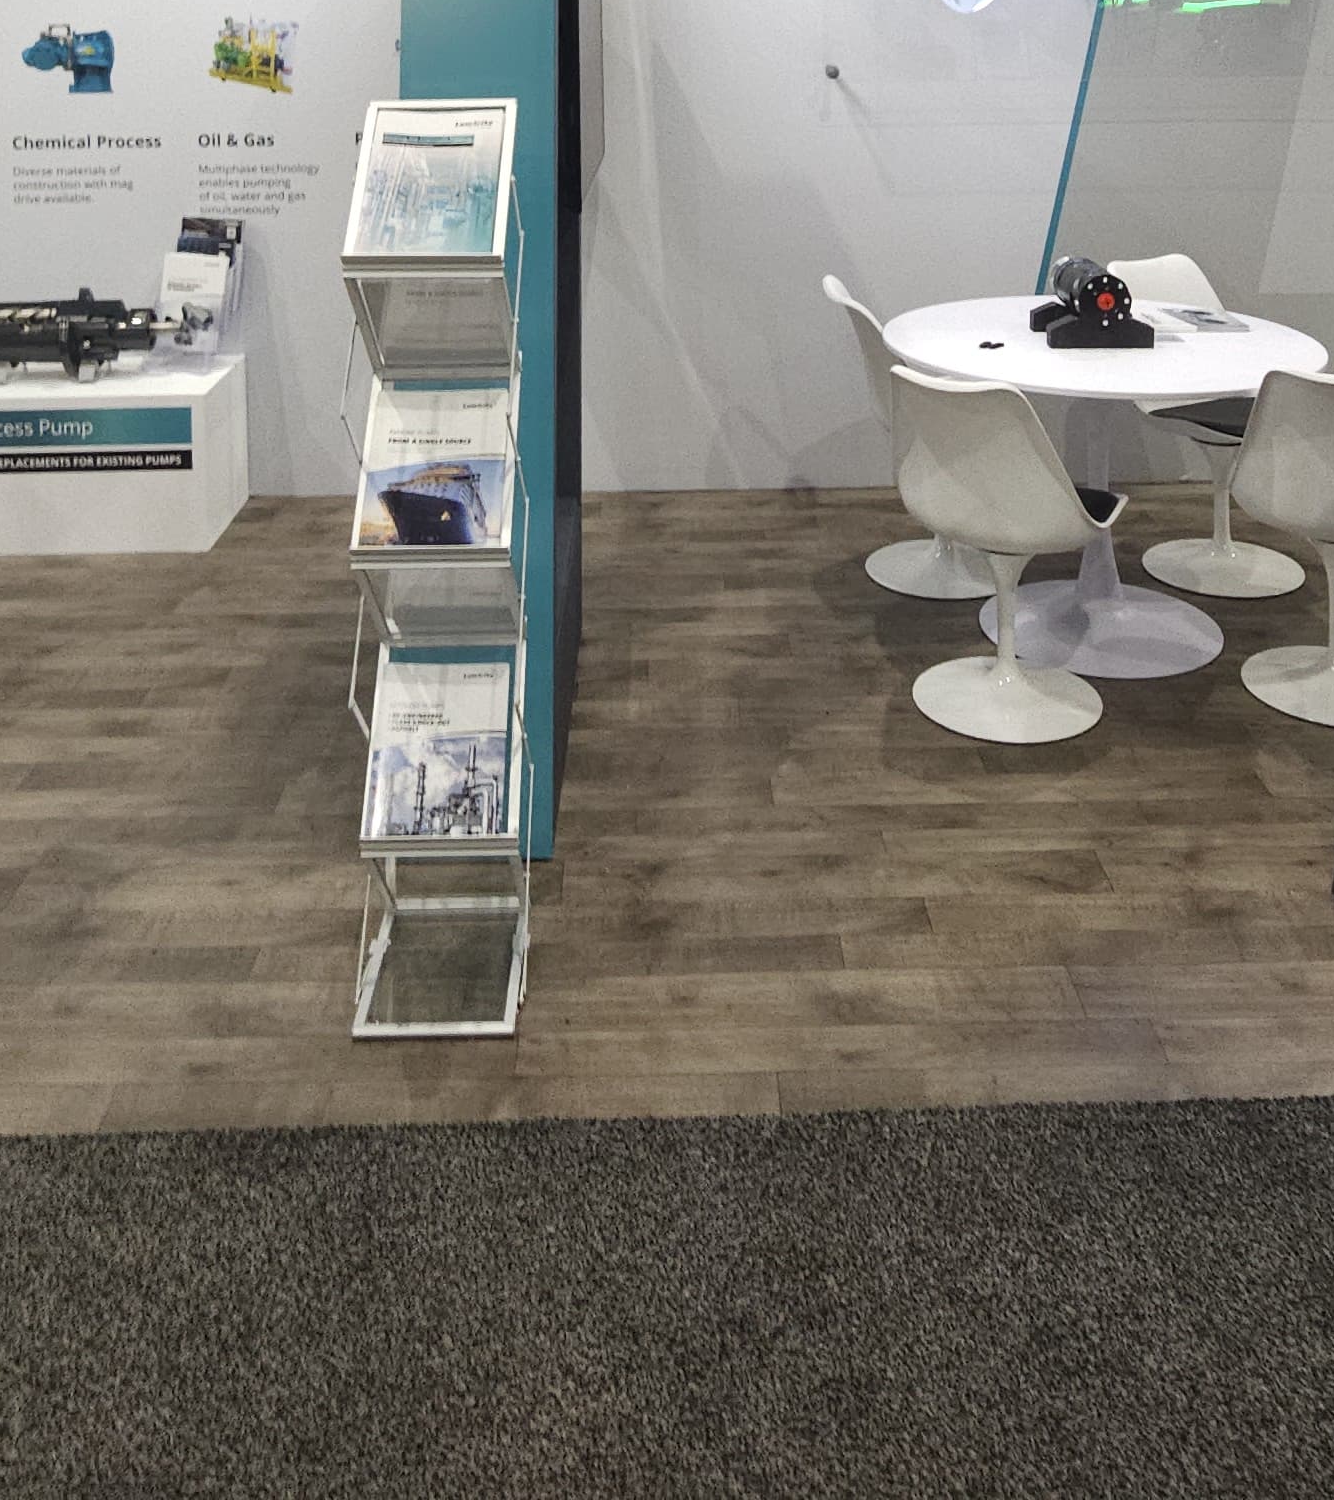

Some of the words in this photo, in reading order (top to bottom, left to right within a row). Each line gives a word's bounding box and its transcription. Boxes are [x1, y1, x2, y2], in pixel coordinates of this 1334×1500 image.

[12, 134, 91, 151] Chemical
[97, 134, 162, 149] Process
[198, 132, 221, 148] Oil
[226, 133, 238, 147] &
[244, 131, 275, 147] Gas
[12, 166, 54, 177] Diverse
[56, 164, 107, 176] materials
[109, 164, 122, 175] of
[198, 163, 258, 176] Multiphase
[260, 162, 320, 176] technology
[13, 180, 82, 191] construction
[83, 179, 107, 189] with
[198, 177, 240, 188] enables
[243, 177, 292, 190] pumping
[13, 193, 41, 204] drive
[199, 191, 211, 202] of
[230, 192, 262, 201] water
[264, 190, 286, 201] and
[287, 192, 307, 204] gas
[199, 204, 281, 217] simultaneously
[38, 417, 94, 440] Pump
[73, 455, 94, 468] FOR
[96, 454, 144, 468] EXISTING
[145, 453, 183, 467] PUMPS
